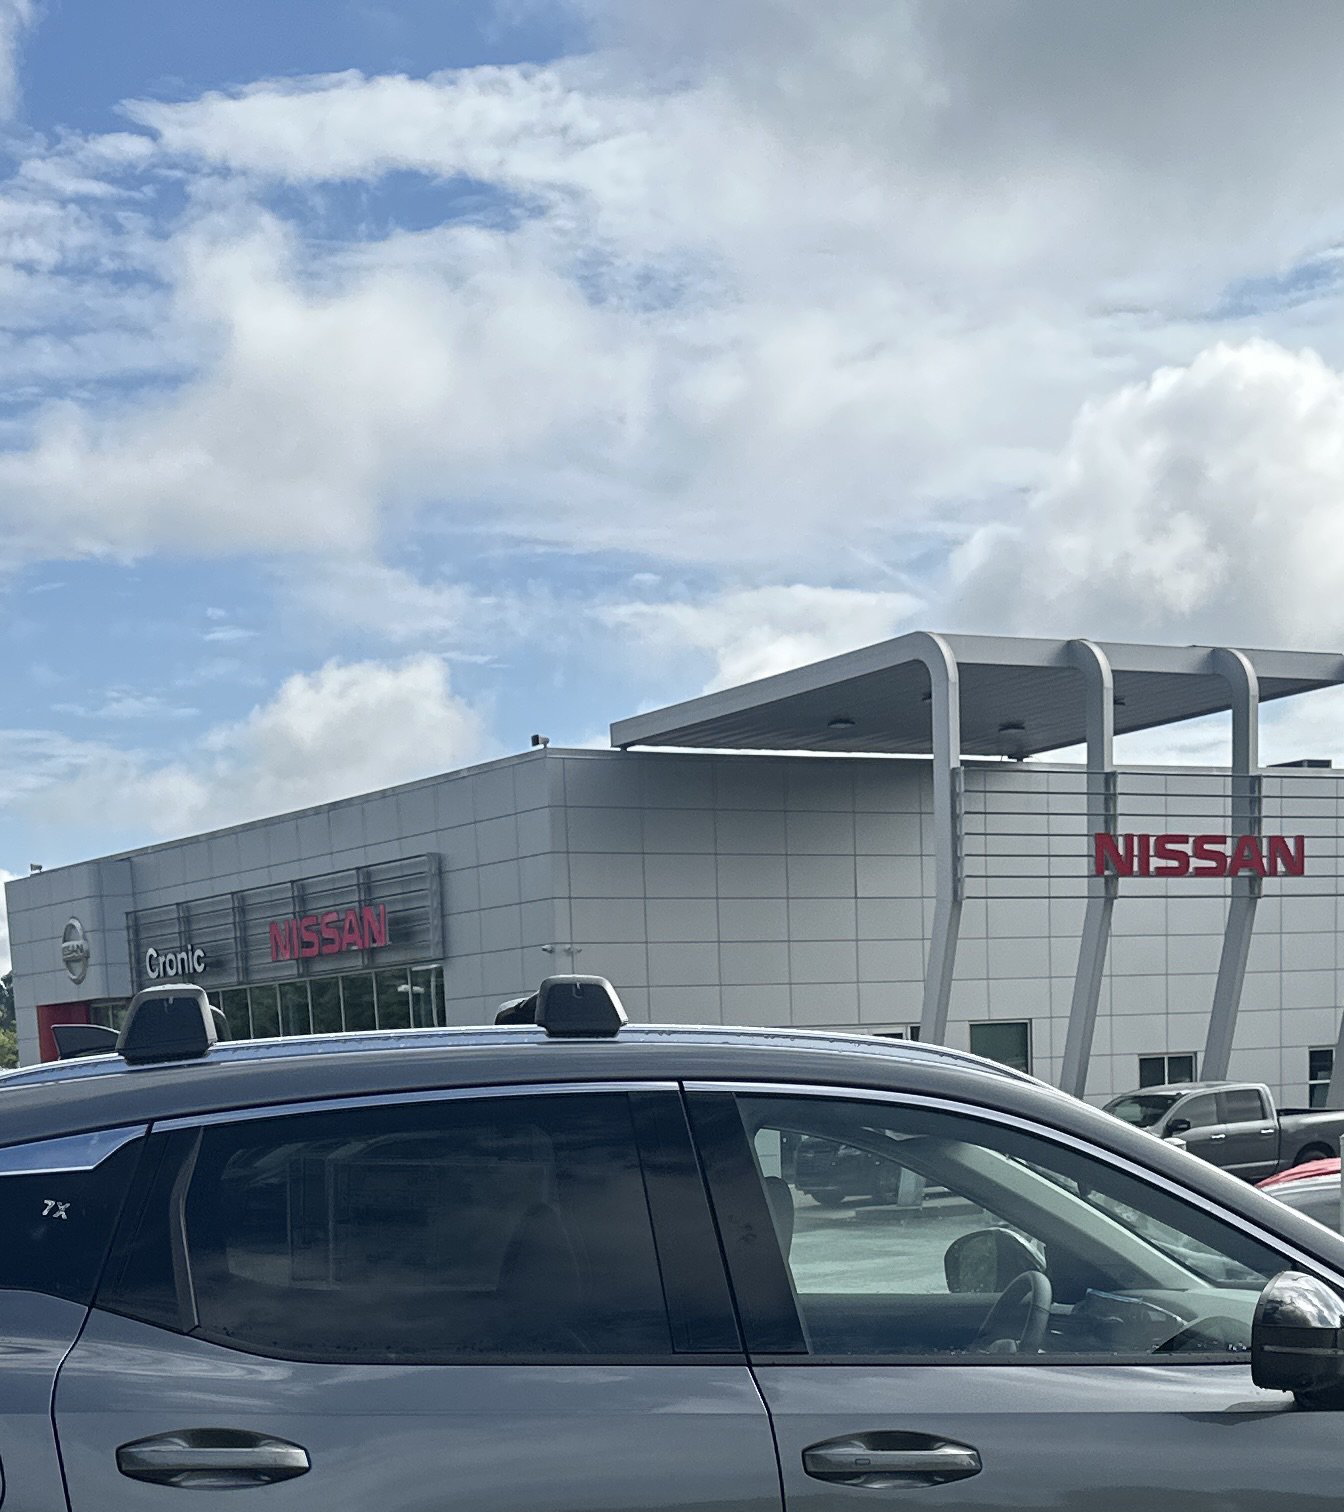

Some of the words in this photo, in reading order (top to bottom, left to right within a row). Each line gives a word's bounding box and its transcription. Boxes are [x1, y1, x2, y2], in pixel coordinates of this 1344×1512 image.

[1094, 832, 1304, 877] NISSAN
[269, 903, 386, 961] NISSAN
[146, 944, 204, 978] Cronic
